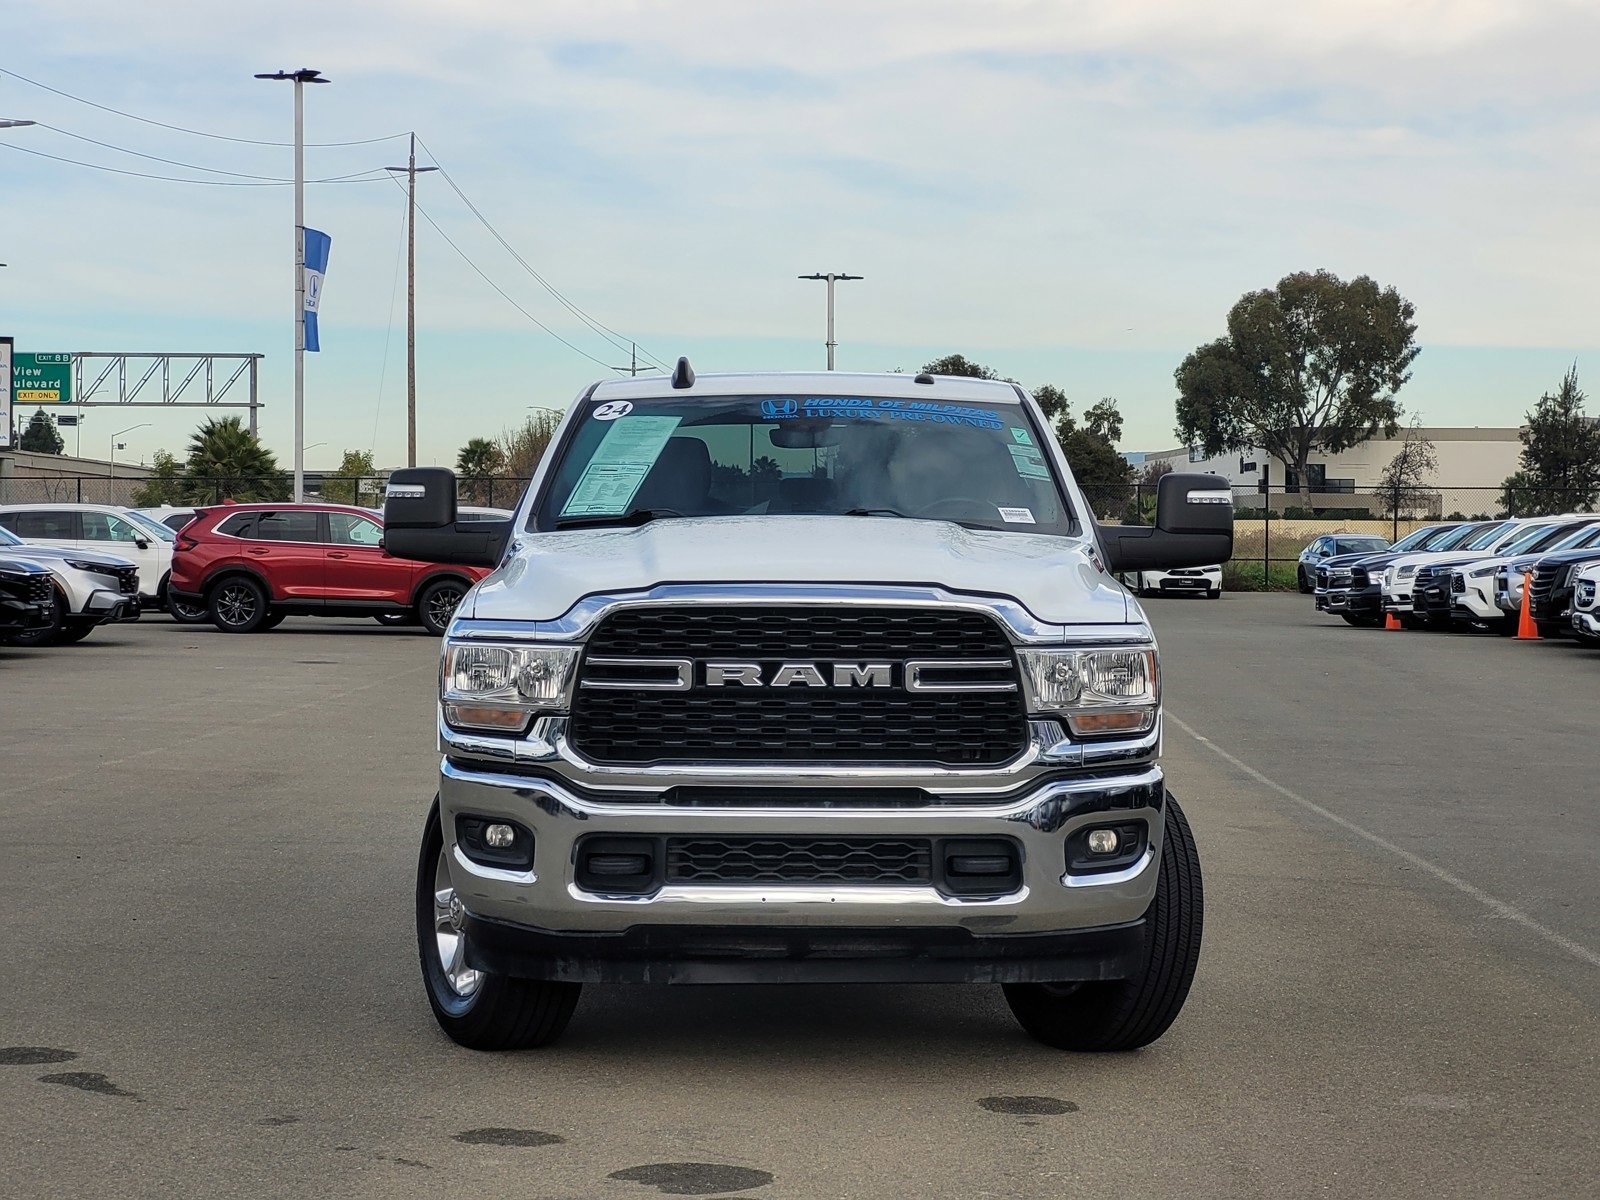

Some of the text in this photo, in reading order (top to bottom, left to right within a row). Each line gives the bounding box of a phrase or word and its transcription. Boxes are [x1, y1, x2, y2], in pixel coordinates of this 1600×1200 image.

[13, 366, 42, 376] View
[595, 403, 630, 416] 24
[803, 398, 998, 419] HONDA OF MILPITAS
[804, 408, 1003, 430] LUXURY PRE-OWNED
[705, 663, 893, 688] RAM
